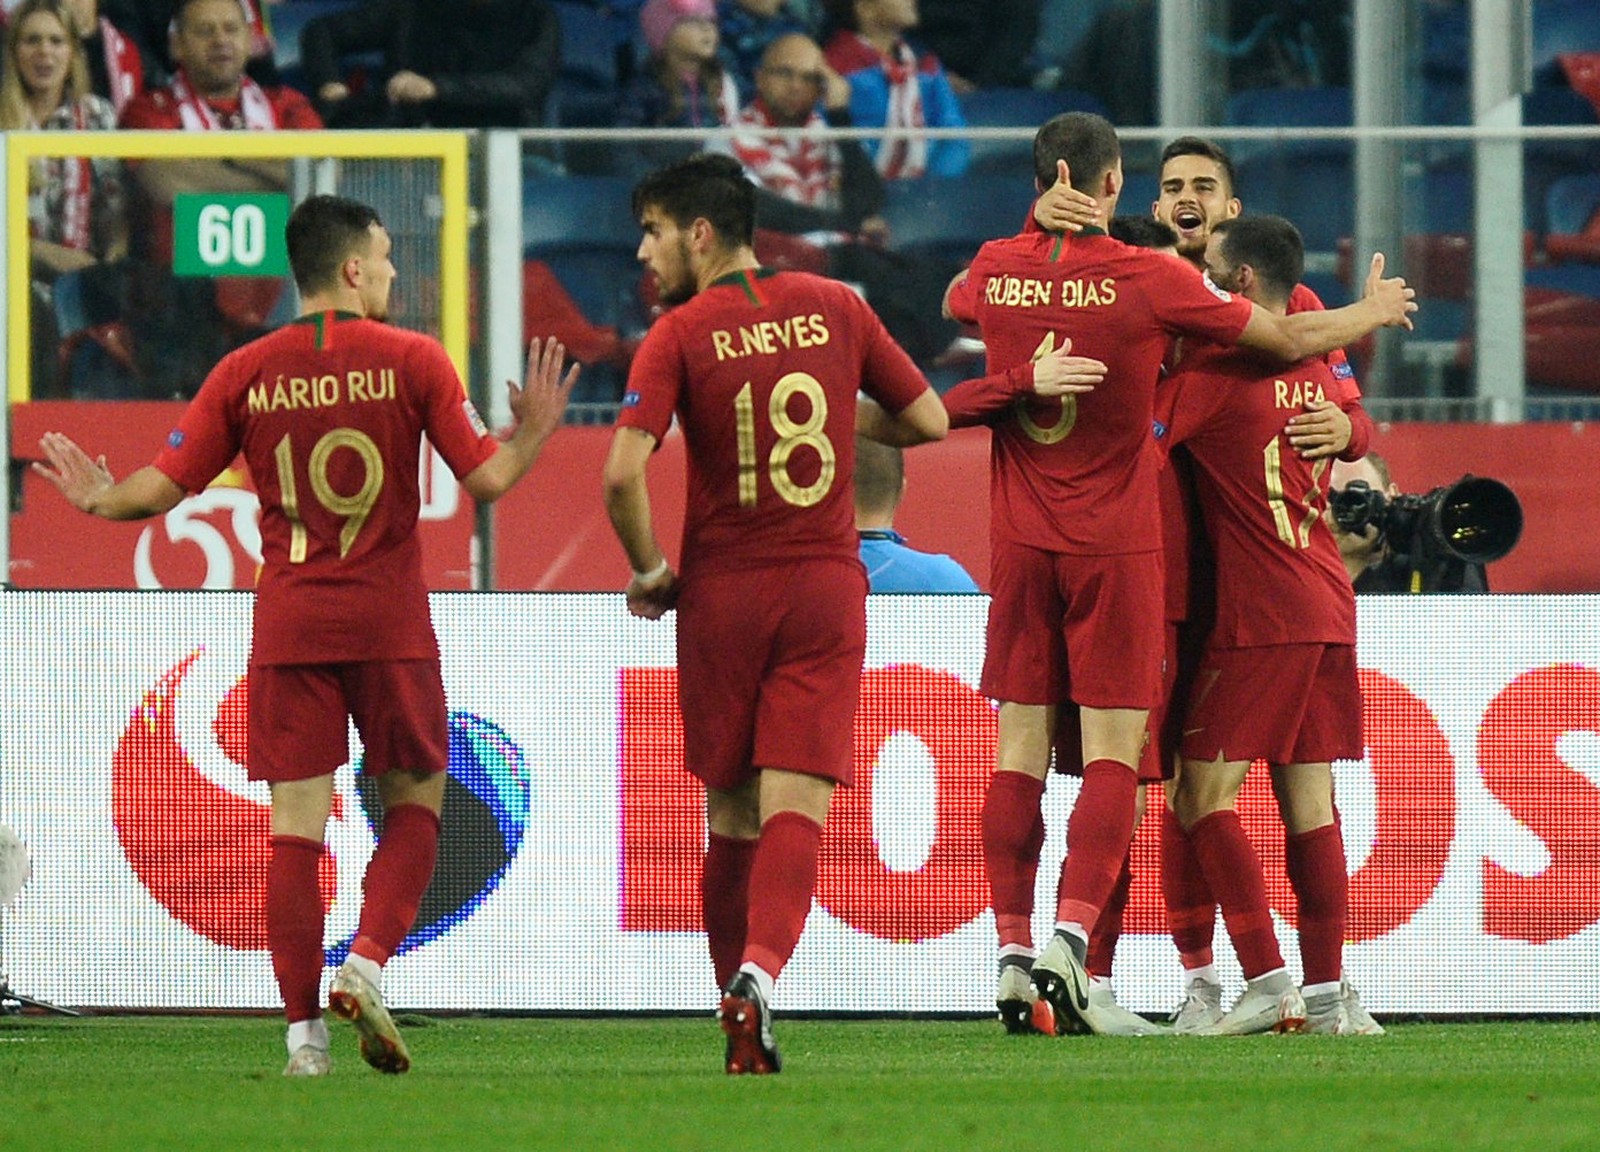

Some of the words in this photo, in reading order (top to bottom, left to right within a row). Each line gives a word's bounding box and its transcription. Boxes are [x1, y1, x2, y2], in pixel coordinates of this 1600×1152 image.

[198, 203, 266, 267] 60
[985, 274, 1052, 308] RÚBEN
[1061, 278, 1117, 308] DIAS
[712, 314, 830, 361] R.NEVES
[248, 374, 339, 414] MÁRIO
[347, 369, 396, 403] RUI
[734, 371, 836, 508] 18
[274, 427, 384, 564] 19
